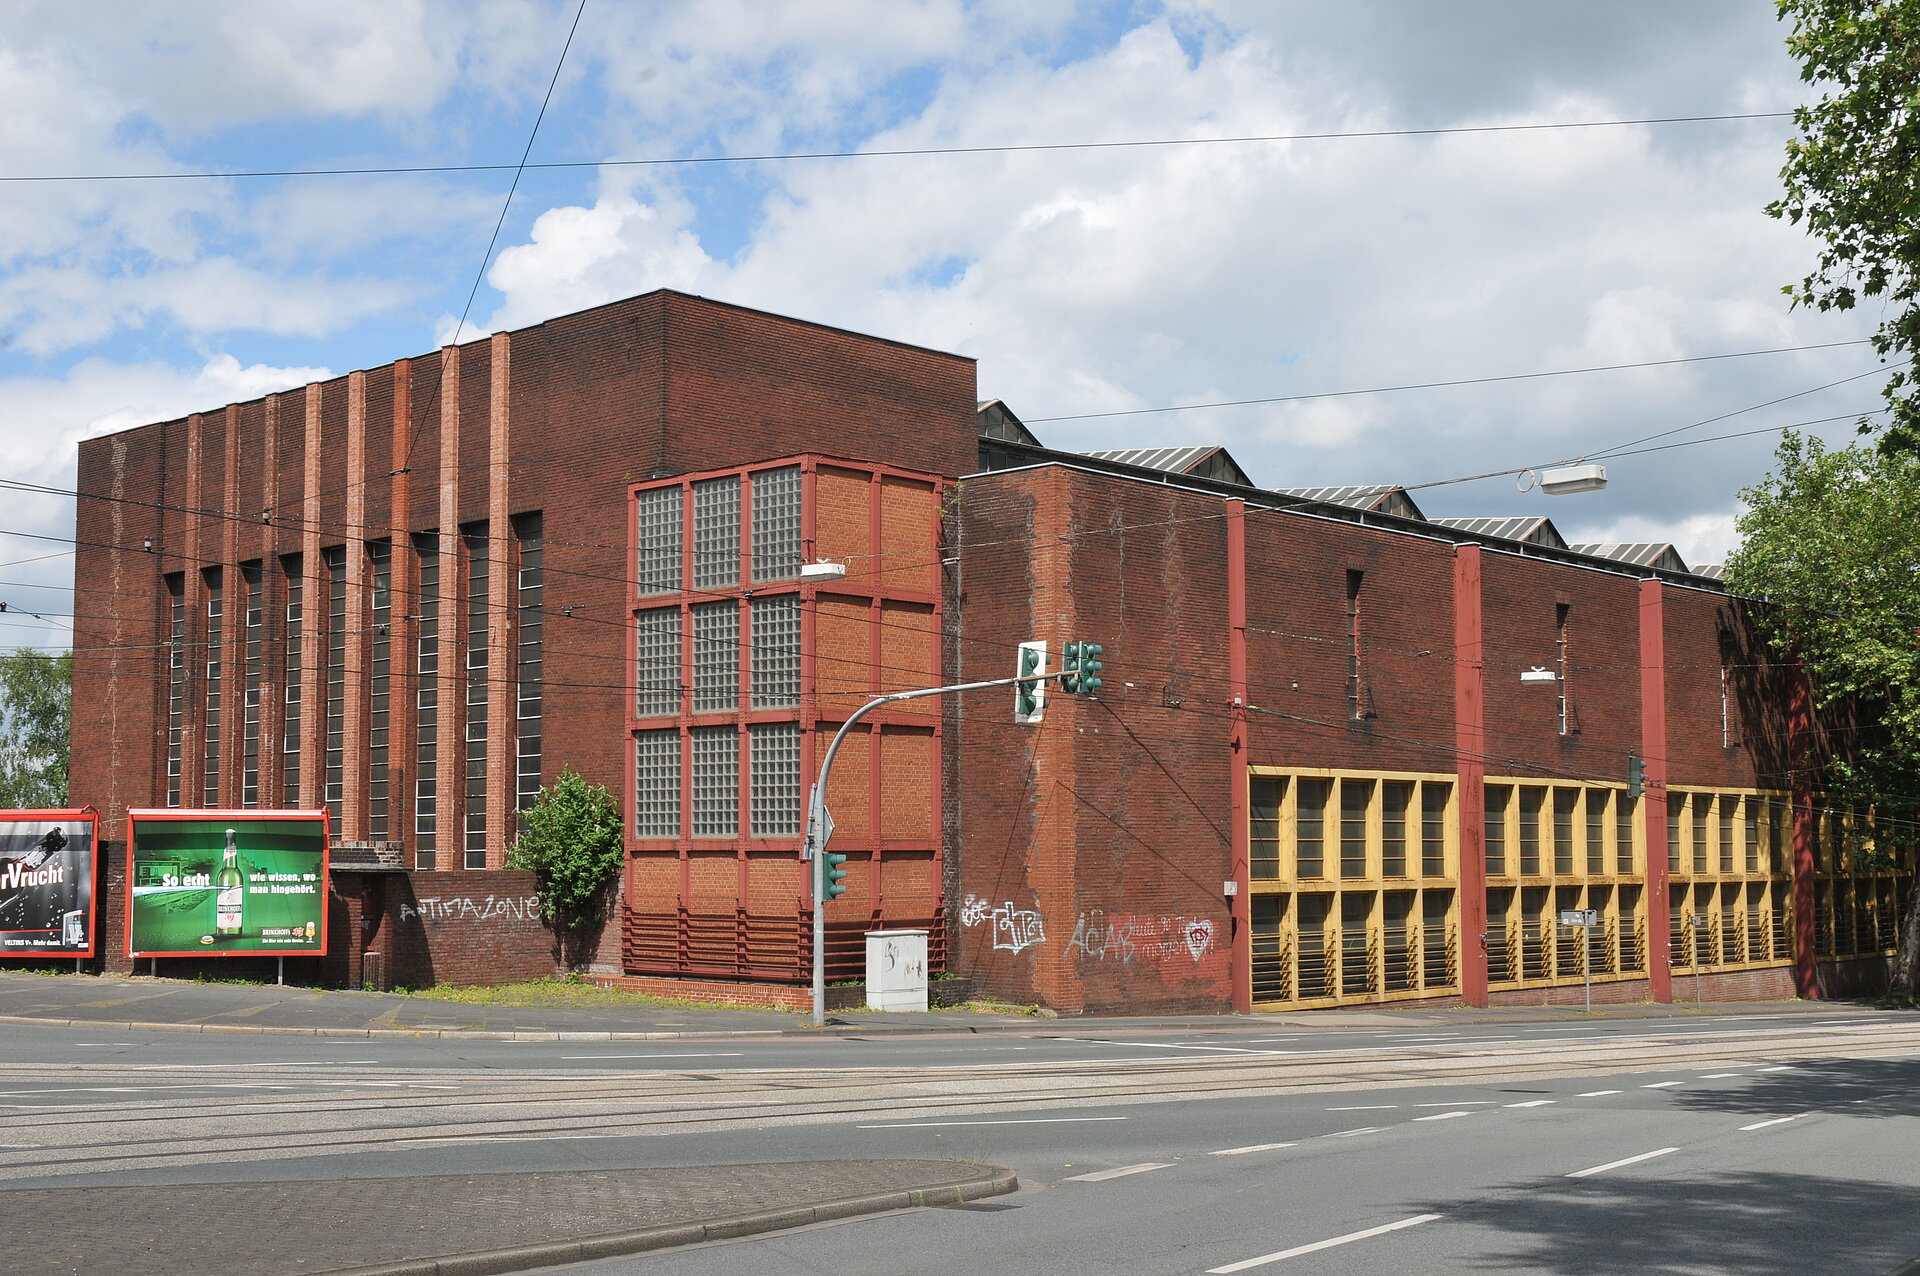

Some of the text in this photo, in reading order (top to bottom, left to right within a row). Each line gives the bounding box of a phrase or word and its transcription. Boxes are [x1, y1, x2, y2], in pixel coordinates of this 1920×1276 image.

[162, 872, 210, 888] So echt
[250, 873, 316, 883] wie wissen, wo
[250, 884, 316, 895] man hingehört.
[1063, 918, 1136, 965] ACAB
